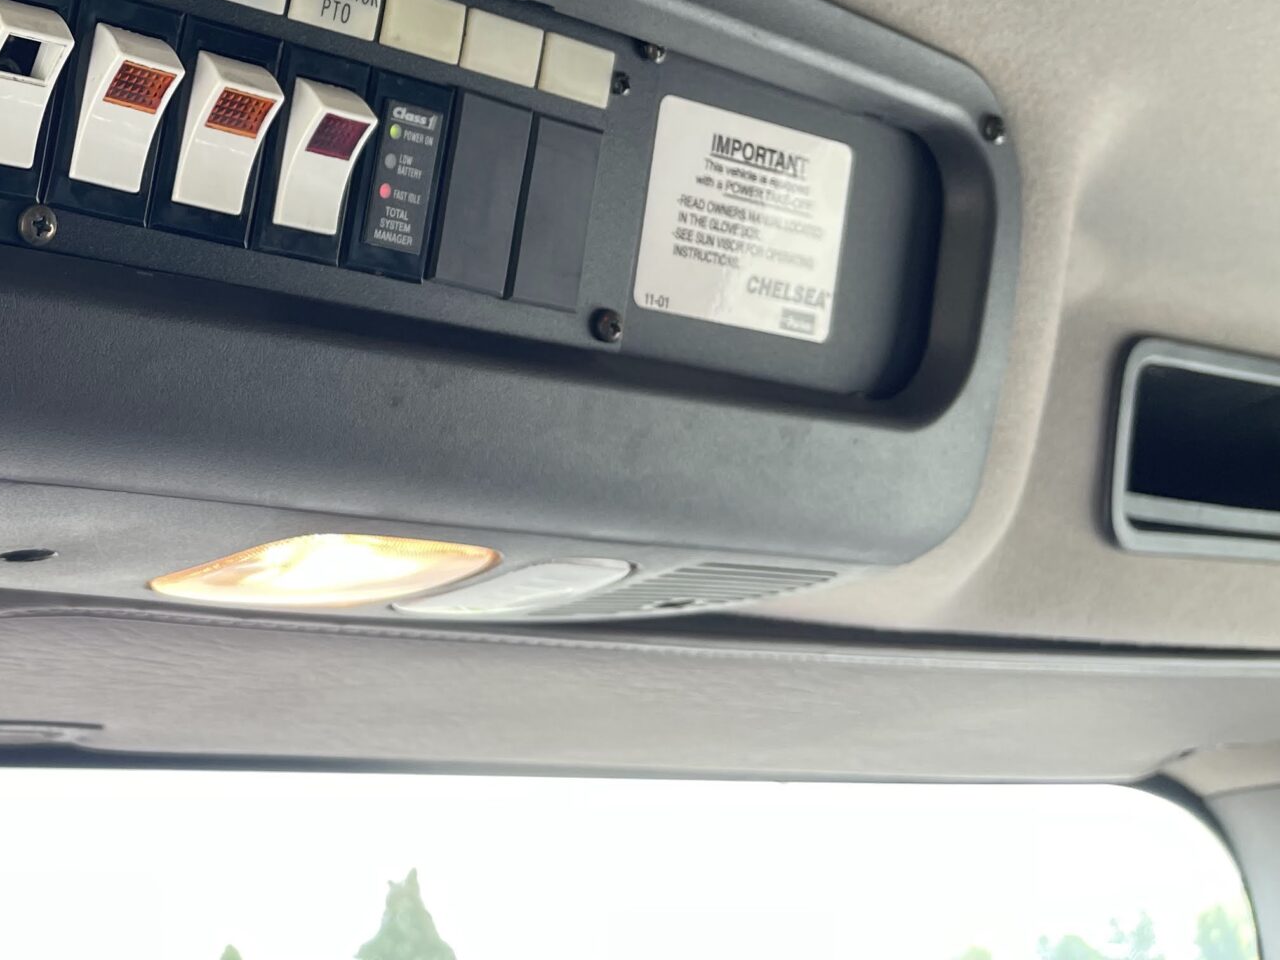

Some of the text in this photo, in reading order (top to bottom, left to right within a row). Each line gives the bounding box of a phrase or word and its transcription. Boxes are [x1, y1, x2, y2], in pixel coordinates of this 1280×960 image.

[392, 106, 427, 125] Class
[403, 130, 433, 146] POWER ON
[399, 154, 413, 166] LOW
[711, 133, 809, 176] IMPORTANT
[397, 166, 422, 180] BATTERY
[695, 176, 715, 188] with
[393, 189, 408, 201] FAST
[385, 206, 409, 221] TOTAL
[678, 211, 688, 224] IN
[689, 214, 707, 229] THE
[379, 218, 412, 234] SYSTEM
[373, 229, 414, 247] MANAGER
[695, 231, 715, 247] SUN
[644, 292, 670, 309] 11-01
[746, 275, 826, 310] CHELSEA
